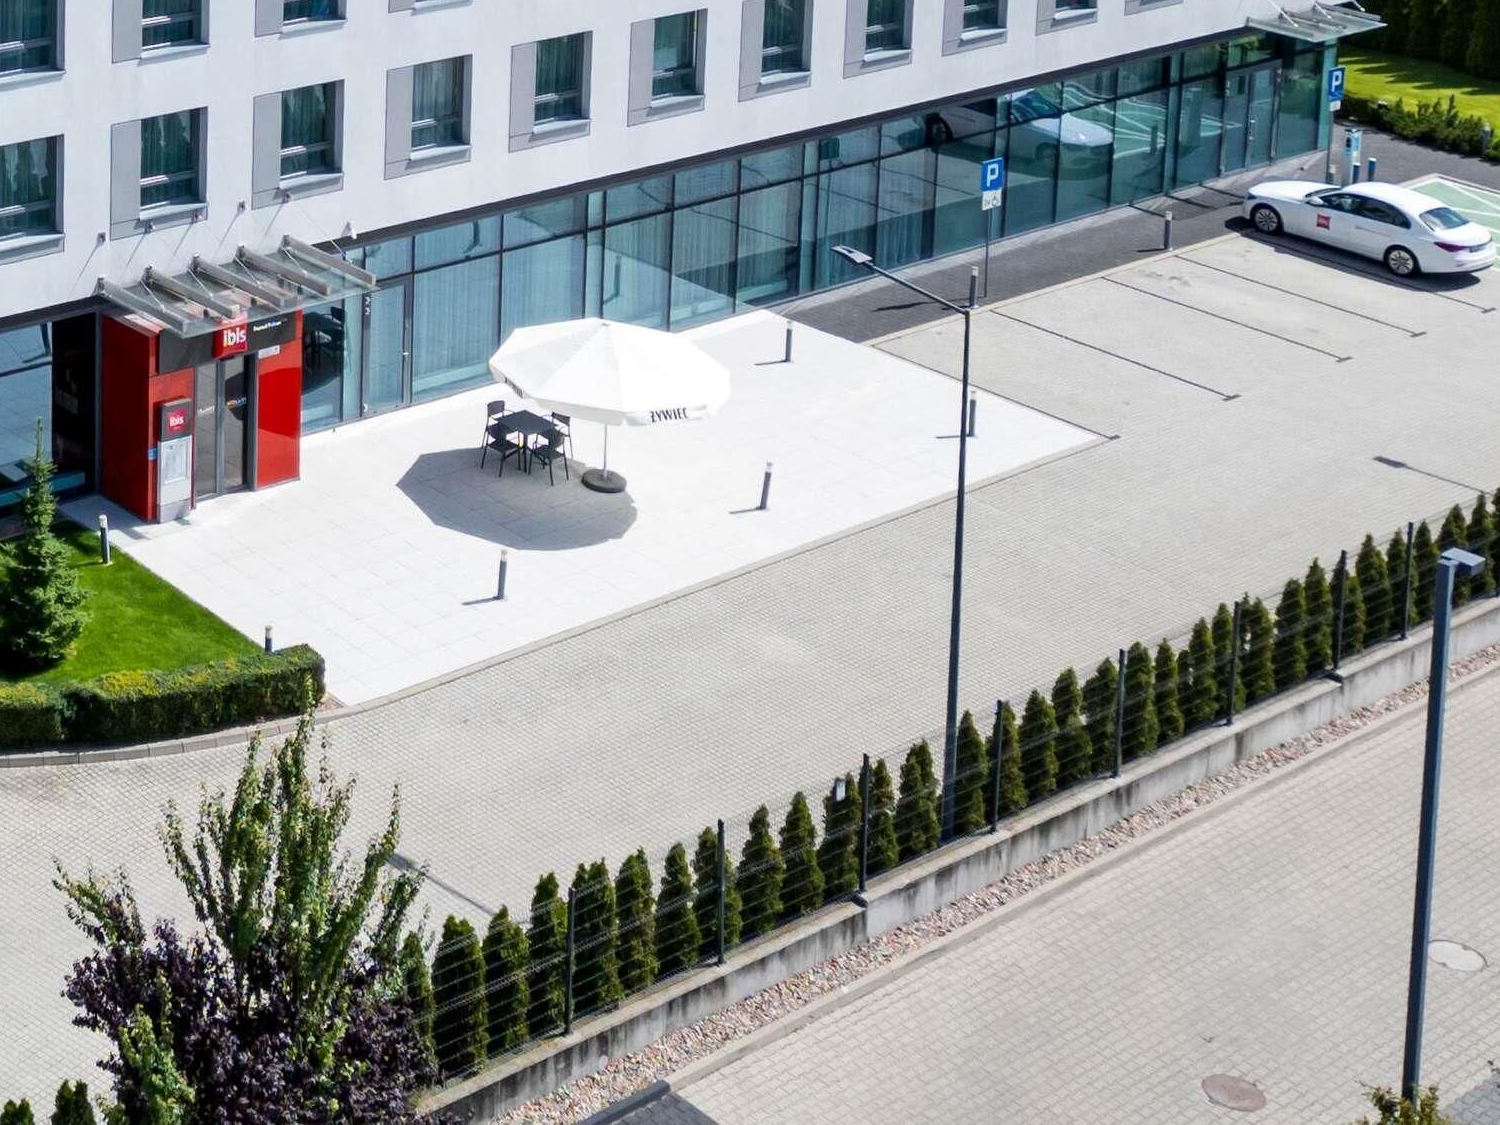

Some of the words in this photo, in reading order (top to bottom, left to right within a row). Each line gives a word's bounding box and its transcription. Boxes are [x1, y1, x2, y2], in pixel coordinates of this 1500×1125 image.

[1331, 71, 1342, 92] P
[986, 163, 999, 188] P
[223, 327, 246, 347] ibis
